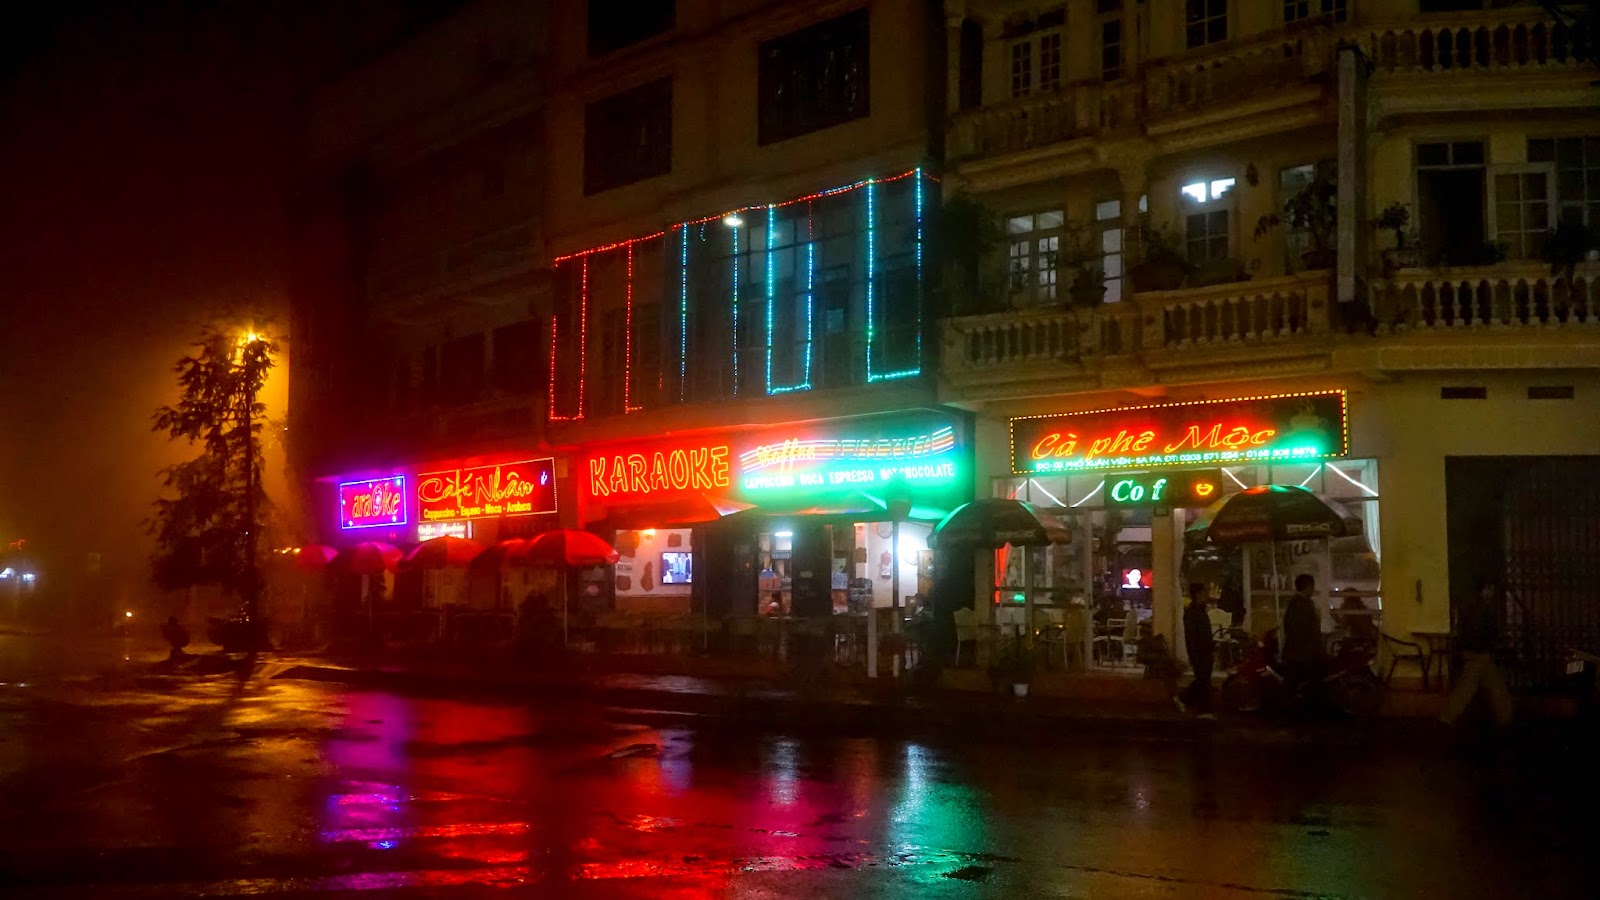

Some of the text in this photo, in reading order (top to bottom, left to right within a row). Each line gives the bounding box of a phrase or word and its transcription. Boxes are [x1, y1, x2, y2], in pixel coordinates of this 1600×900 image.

[1032, 423, 1275, 461] Cà phê Mộc
[475, 466, 534, 504] Nhân
[589, 446, 730, 496] KARAOKE
[829, 469, 875, 484] ESPRESSO
